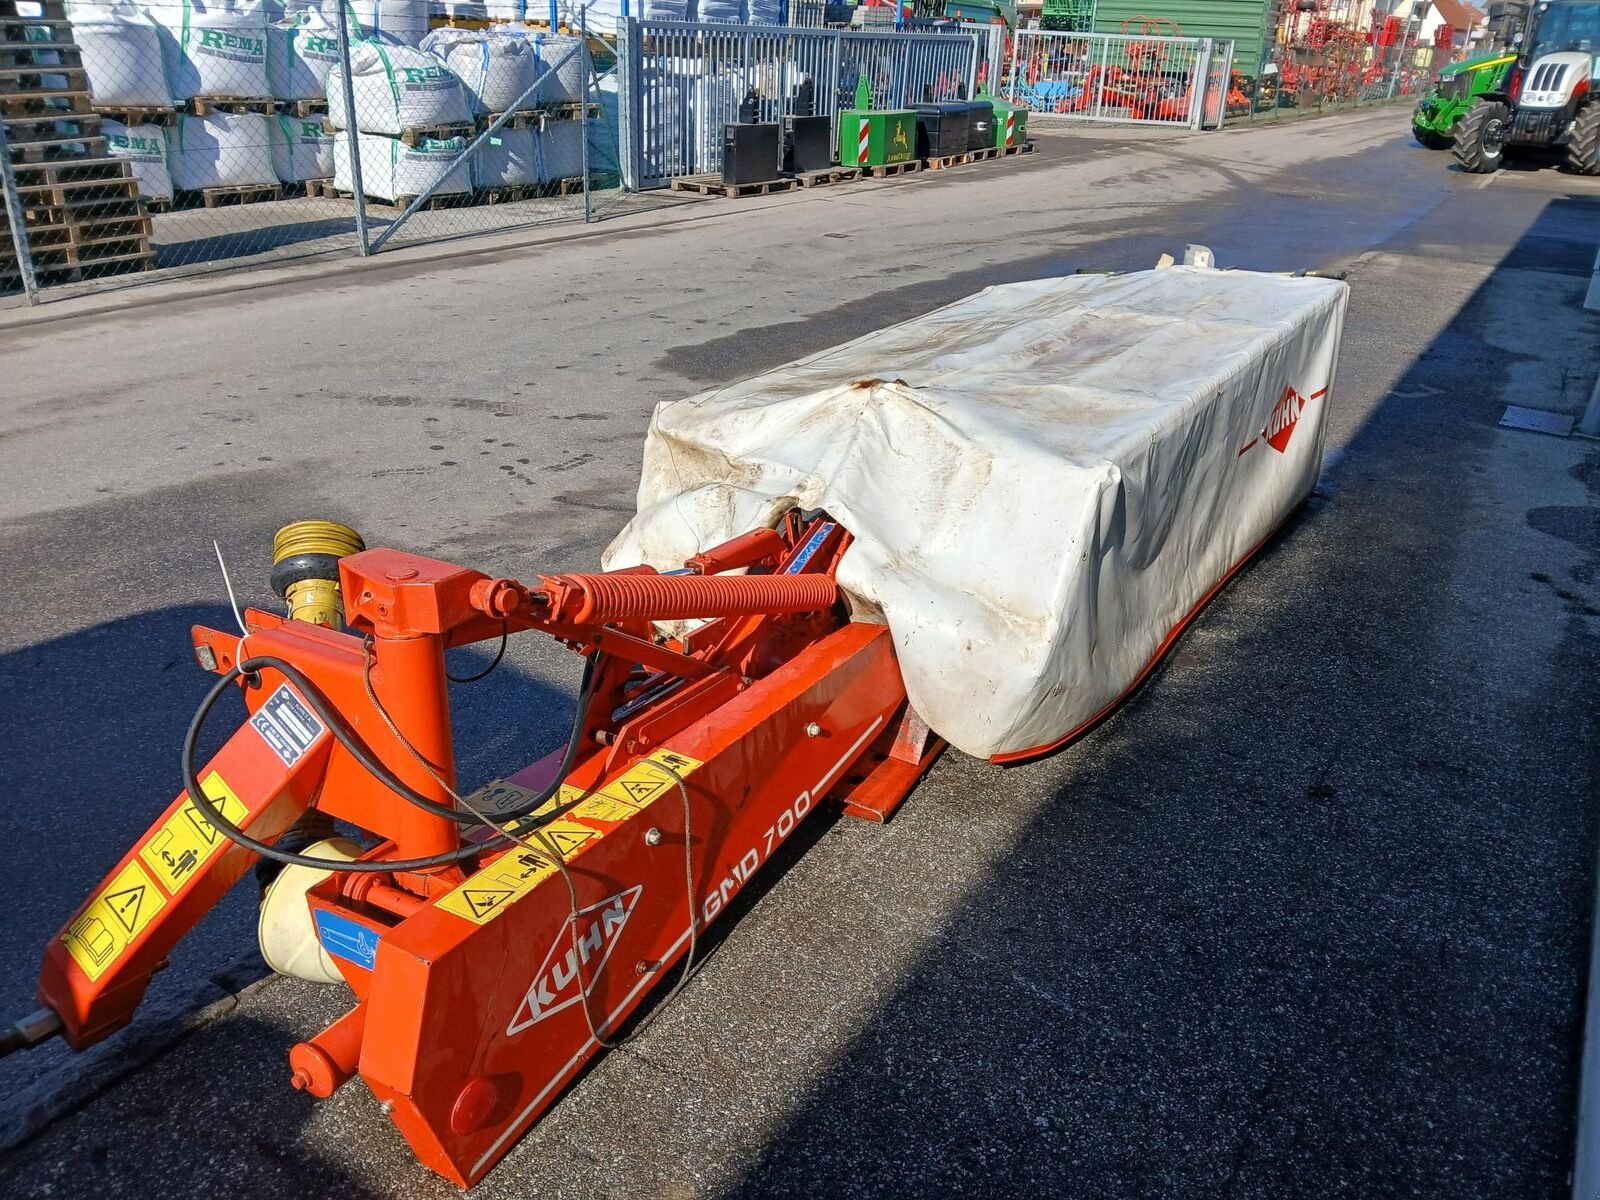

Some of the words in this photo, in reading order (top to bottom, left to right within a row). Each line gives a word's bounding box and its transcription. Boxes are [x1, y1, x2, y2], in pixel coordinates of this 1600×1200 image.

[200, 27, 264, 56] REMA
[305, 36, 339, 53] RE
[1262, 392, 1301, 441] KUHN
[702, 847, 759, 924] GMD
[763, 790, 811, 858] 700
[526, 895, 626, 1021] KUHN
